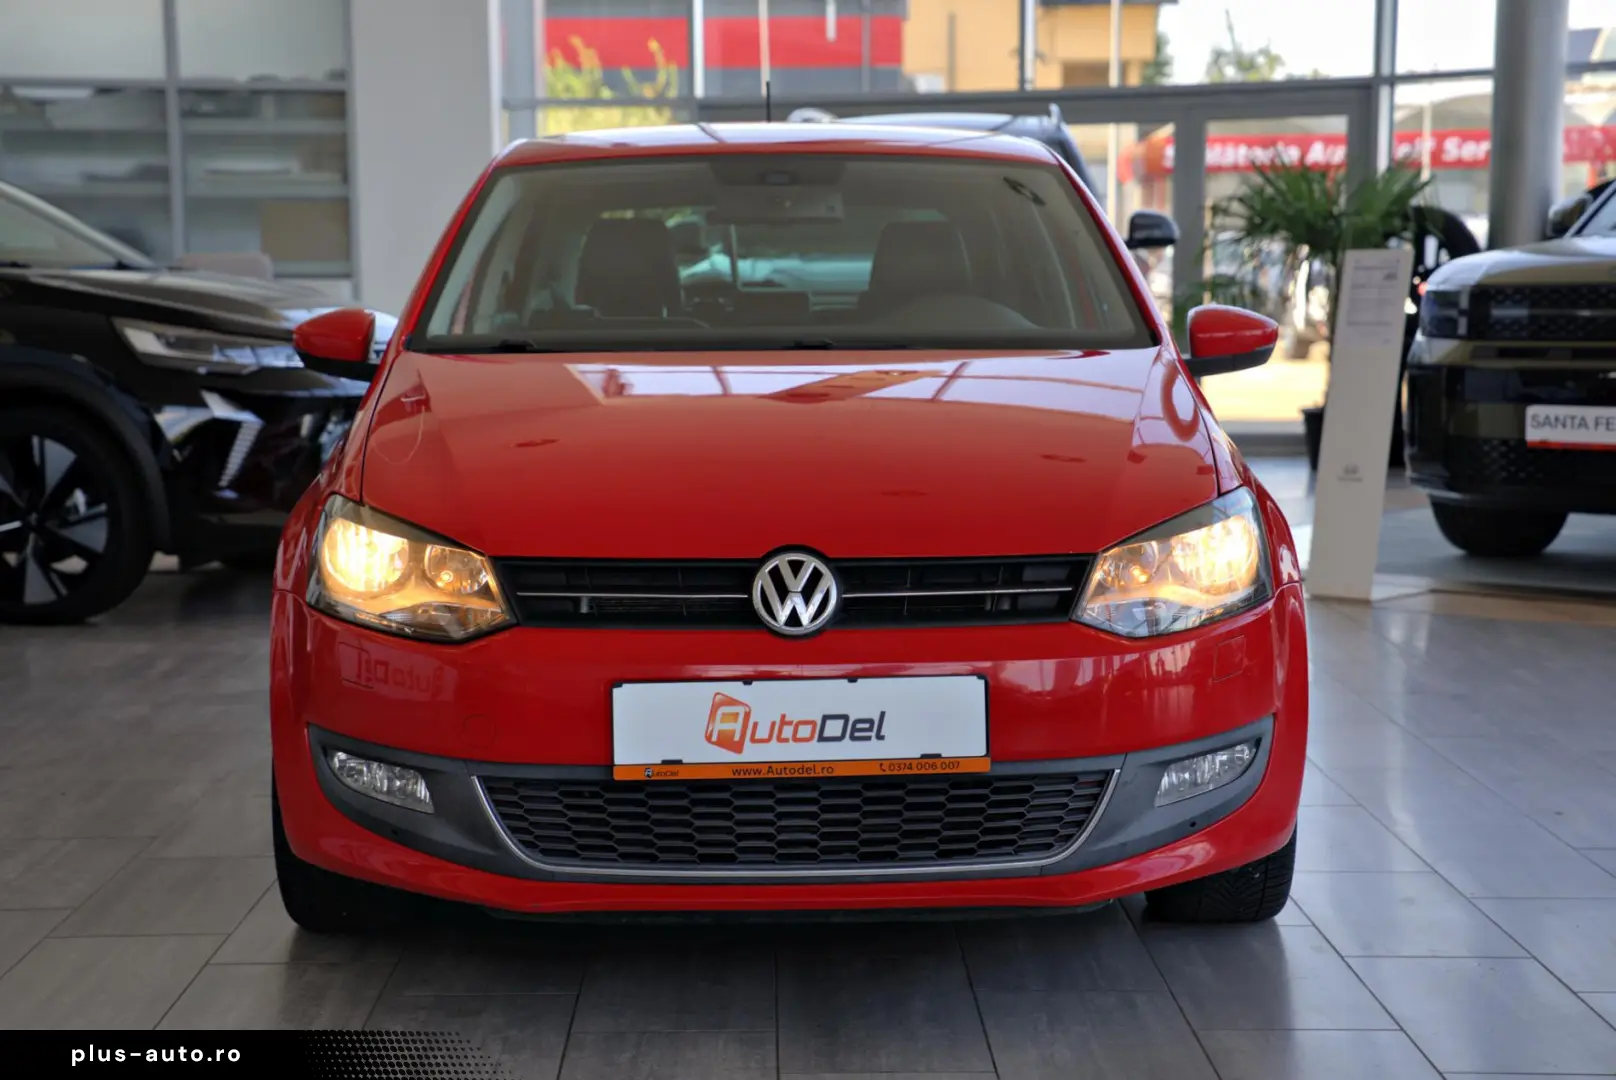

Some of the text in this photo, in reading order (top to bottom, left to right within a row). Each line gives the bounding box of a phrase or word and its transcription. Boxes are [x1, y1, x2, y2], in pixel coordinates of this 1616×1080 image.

[1530, 413, 1616, 432] SANTA FE
[706, 697, 886, 750] AutoDel
[731, 763, 834, 776] www.Autodel.ro
[888, 761, 960, 772] 0374 006 007
